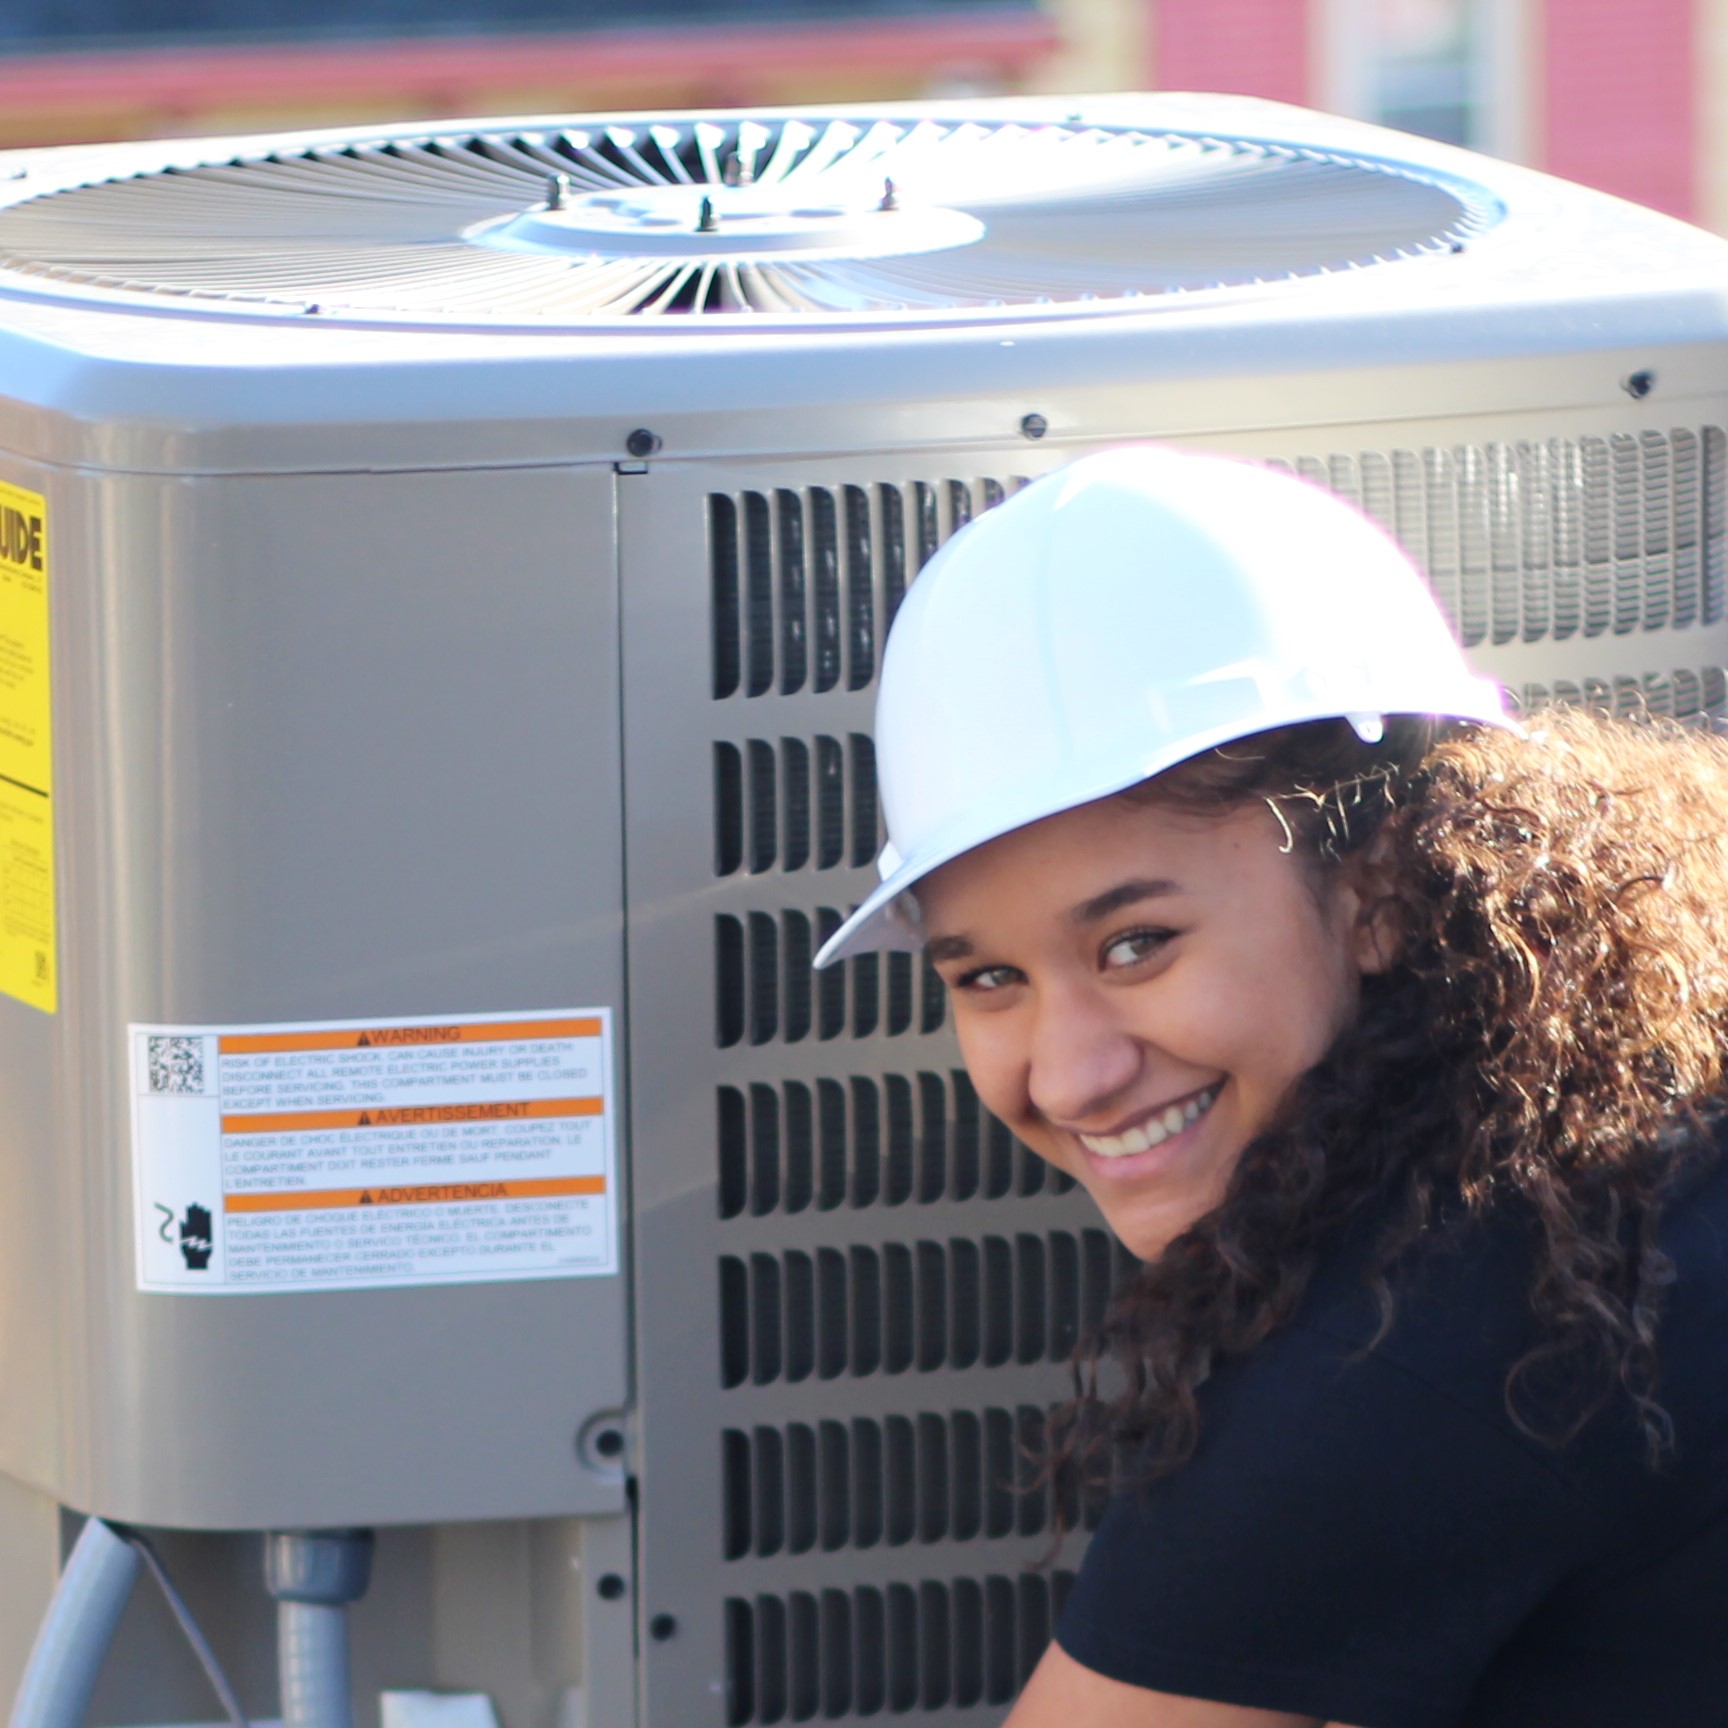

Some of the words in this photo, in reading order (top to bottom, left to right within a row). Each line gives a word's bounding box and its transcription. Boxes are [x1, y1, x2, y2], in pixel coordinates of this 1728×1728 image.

[372, 1027, 461, 1044] WARNING
[222, 1058, 249, 1068] RISK
[254, 1057, 271, 1067] OF
[275, 1054, 334, 1066] ELECTRIC
[388, 1050, 413, 1061] CAN
[418, 1048, 458, 1059] CAUSE
[462, 1046, 504, 1057] INJURY
[509, 1045, 526, 1055] OR
[223, 1069, 302, 1082] DISCONNECT
[307, 1068, 327, 1078] ALL
[332, 1065, 382, 1077] REMOTE
[388, 1062, 448, 1074] ELECTRIC
[451, 1059, 497, 1071] POWER
[501, 1056, 560, 1069] SUPPLIES
[223, 1085, 272, 1096] BEFORE
[352, 1079, 377, 1090] THIS
[382, 1074, 476, 1089] COMPARTMENT
[480, 1072, 514, 1084] MUST
[518, 1071, 533, 1082] BE
[537, 1069, 587, 1081] CLOSED
[223, 1098, 271, 1109] EXCEPT
[276, 1096, 313, 1107] WHEN
[377, 1103, 532, 1123] AVERTISSEMENT
[224, 1136, 276, 1148] DANGER
[280, 1135, 295, 1145] DE
[300, 1133, 334, 1144] CHOC
[420, 1128, 439, 1138] OU
[442, 1127, 458, 1137] DE
[504, 1122, 555, 1134] COUPEZ
[559, 1120, 592, 1132] TOUT
[224, 1151, 239, 1162] LE
[243, 1148, 302, 1161] COURANT
[307, 1146, 347, 1158] AVANT
[352, 1144, 384, 1156] TOUT
[388, 1141, 456, 1154] ENTRETIEN
[460, 1140, 477, 1151] OU
[567, 1135, 582, 1146] LE
[224, 1162, 323, 1176] COMPARTIMENT
[328, 1160, 355, 1170] DOIT
[360, 1157, 408, 1169] RESTER
[459, 1153, 490, 1164] SAUF
[494, 1150, 552, 1162] PENDANT
[379, 1184, 508, 1203] ADVERTENCIA
[228, 1215, 281, 1226] PELIGRO
[285, 1214, 301, 1224] DE
[305, 1211, 358, 1223] CHOQUE
[505, 1200, 589, 1213] DESCONECTE
[229, 1239, 330, 1254] MANTENIMIENTO
[466, 1232, 480, 1242] EL
[484, 1226, 592, 1241] COMPARTIMENTO
[230, 1229, 269, 1240] TODAS
[273, 1228, 296, 1238] LAS
[300, 1225, 356, 1237] FUENTES
[360, 1224, 376, 1234] DE
[510, 1216, 550, 1227] ANTES
[554, 1215, 569, 1225] DE
[229, 1257, 262, 1268] DEBE
[266, 1252, 350, 1266] PERMANECER
[355, 1249, 415, 1261] CERRADO
[419, 1246, 476, 1258] EXCEPTO
[479, 1243, 537, 1255] DURANTE
[540, 1242, 555, 1252] EL
[230, 1269, 288, 1280] SERVICIO
[291, 1268, 307, 1278] DE
